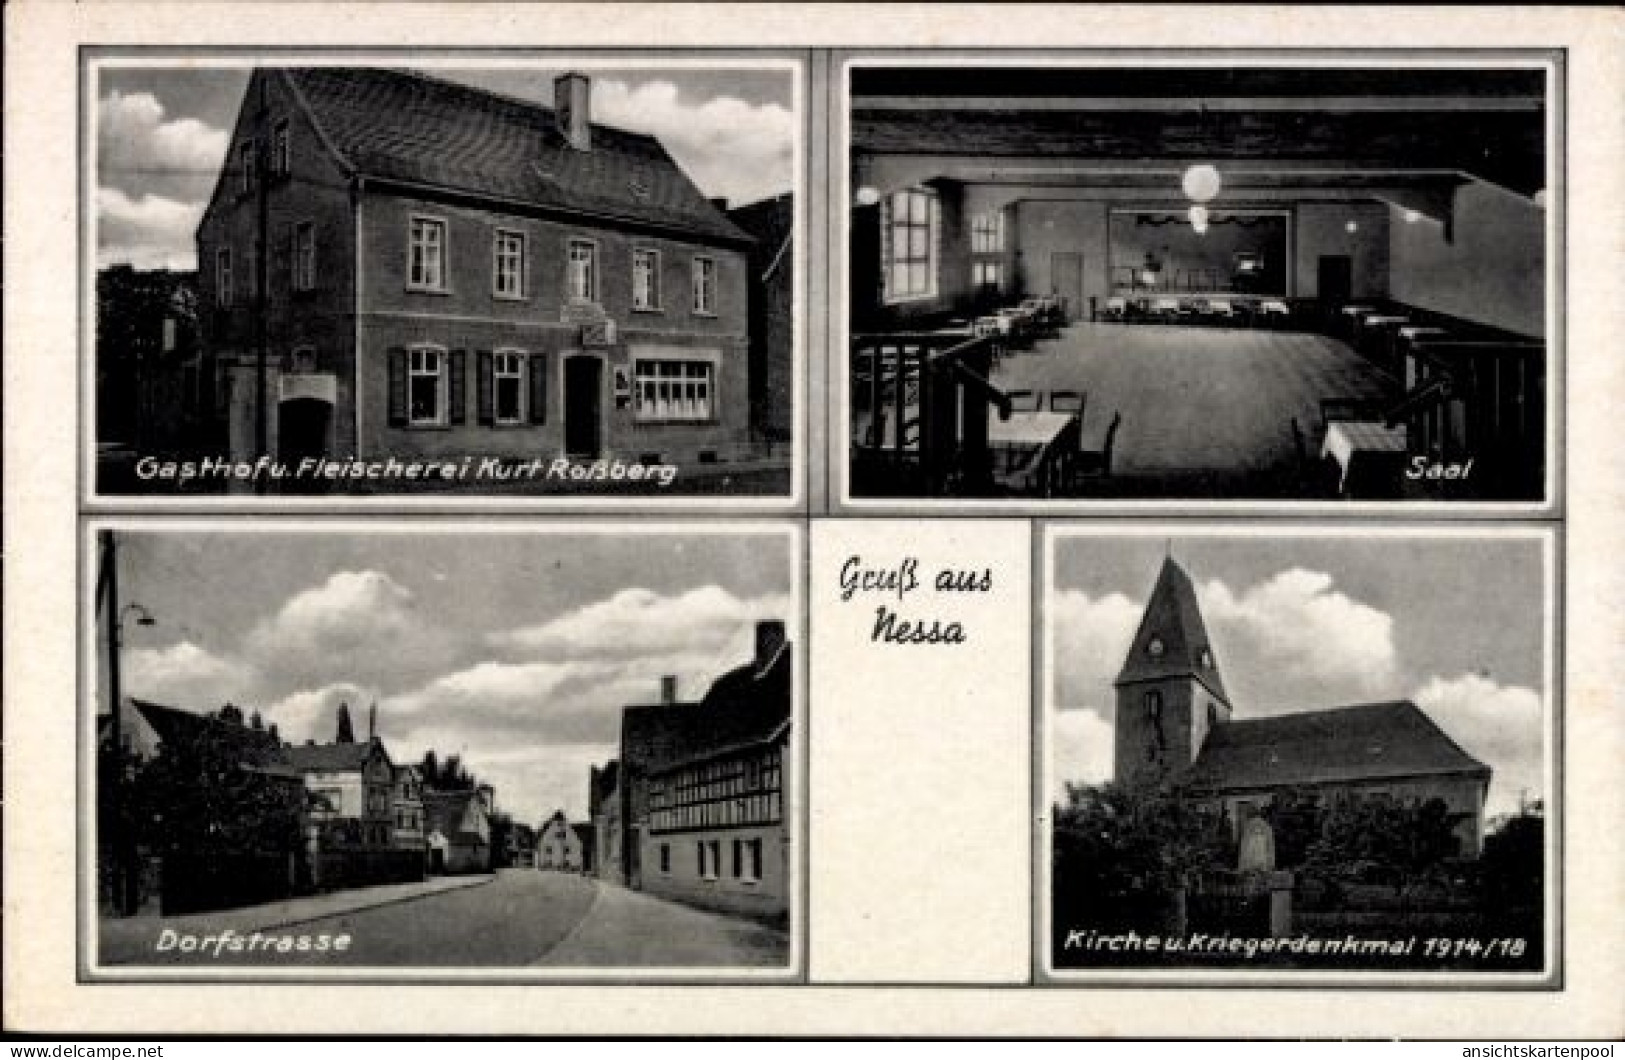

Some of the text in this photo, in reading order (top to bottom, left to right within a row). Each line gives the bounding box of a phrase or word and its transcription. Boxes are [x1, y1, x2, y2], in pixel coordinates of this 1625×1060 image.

[840, 555, 993, 602] Gruß aus
[871, 604, 967, 645] Nessa
